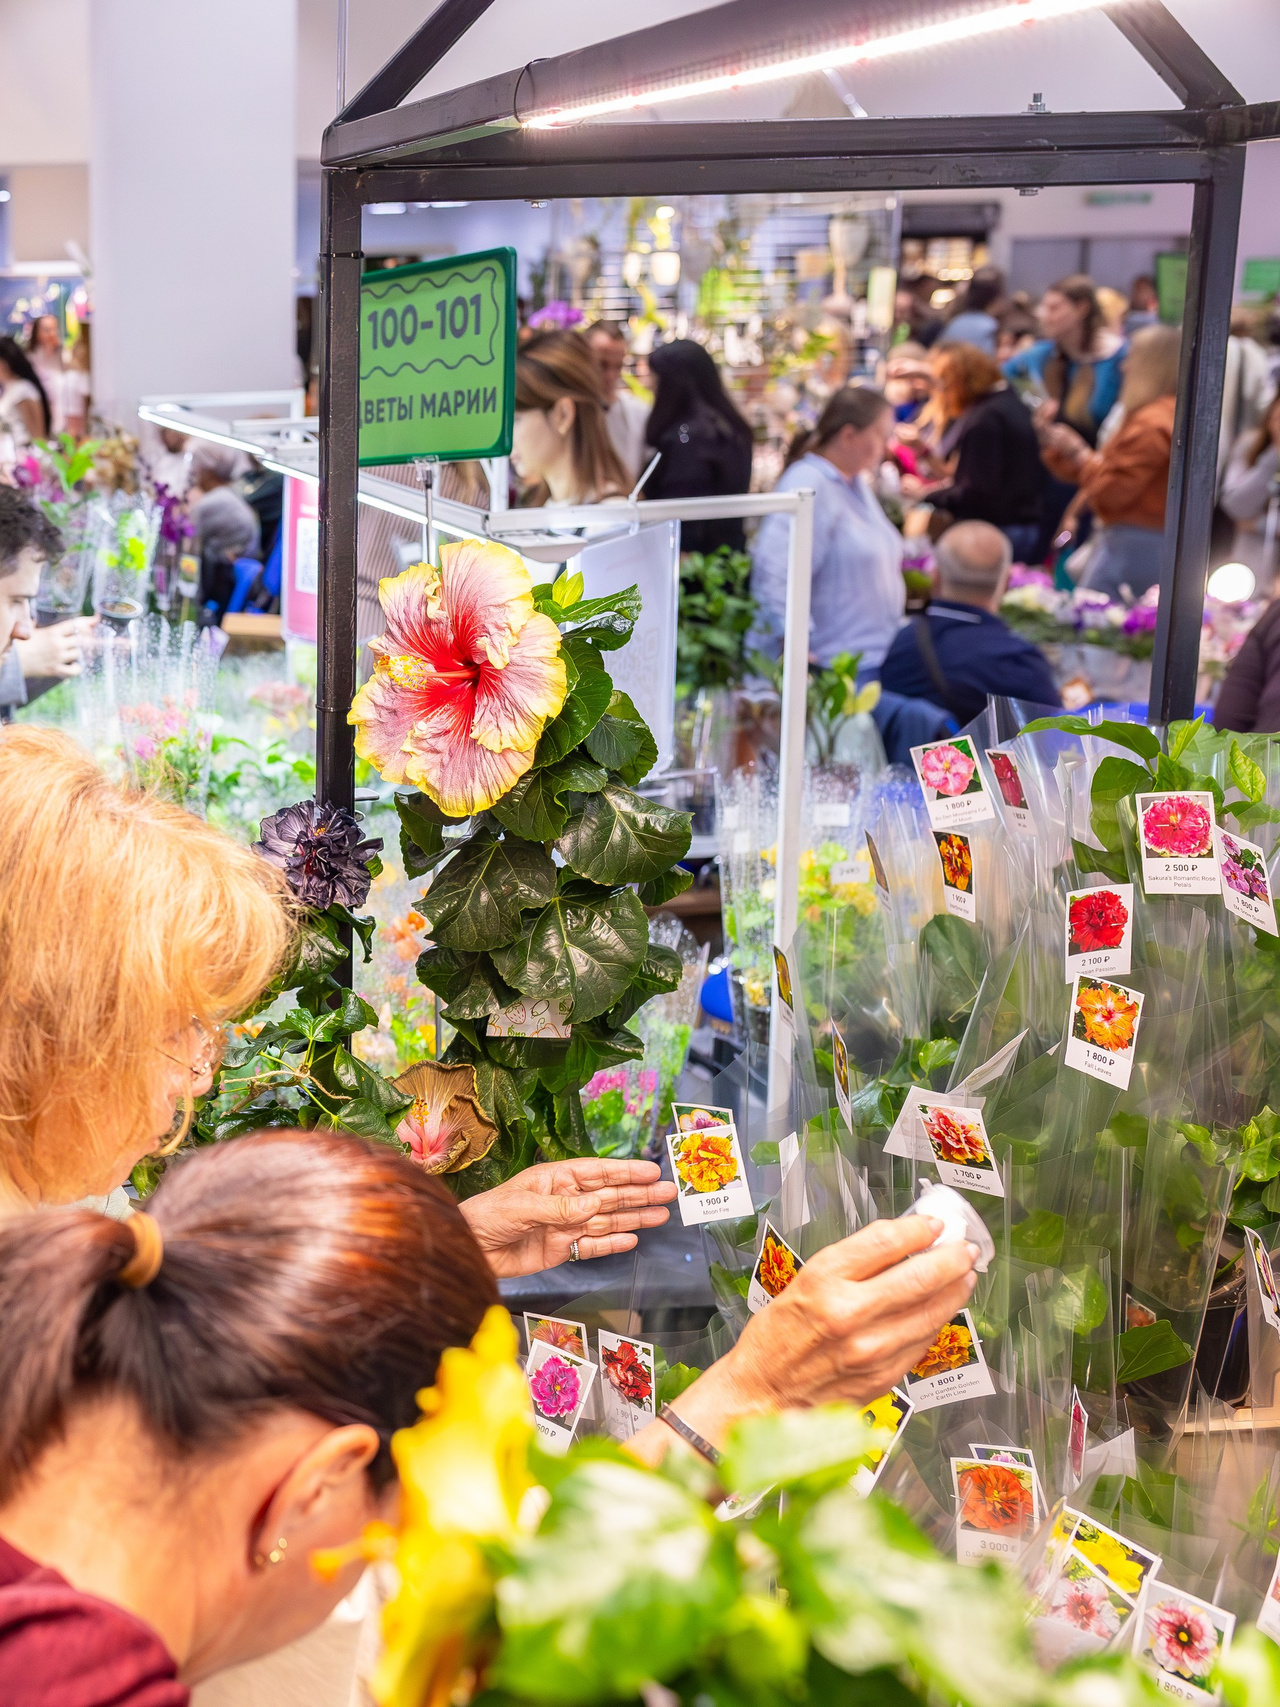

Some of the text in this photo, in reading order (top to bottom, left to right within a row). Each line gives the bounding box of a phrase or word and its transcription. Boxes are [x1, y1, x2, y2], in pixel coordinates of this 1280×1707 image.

[368, 294, 481, 350] 100-101
[359, 387, 497, 429] ВЕТЫ МАРИИ
[951, 801, 965, 810] 800
[1164, 864, 1171, 872] 2
[1173, 864, 1189, 872] 500
[1081, 959, 1087, 967] 2
[1088, 956, 1102, 966] 100
[1086, 1049, 1091, 1058] 1
[1092, 1052, 1107, 1065] 800
[1084, 1060, 1112, 1077] Fall Leaves
[954, 1168, 959, 1176] 1
[959, 1170, 975, 1179] 700
[699, 1199, 704, 1207] 1
[706, 1197, 722, 1206] 900
[702, 1208, 718, 1216] Moon
[937, 1376, 955, 1386] 800
[935, 1386, 957, 1395] Garden
[957, 1380, 980, 1389] Golden
[936, 1393, 953, 1401] Earth
[980, 1540, 987, 1549] 3
[989, 1541, 1009, 1552] 000
[1155, 1677, 1161, 1687] 1
[1163, 1681, 1184, 1699] 800
